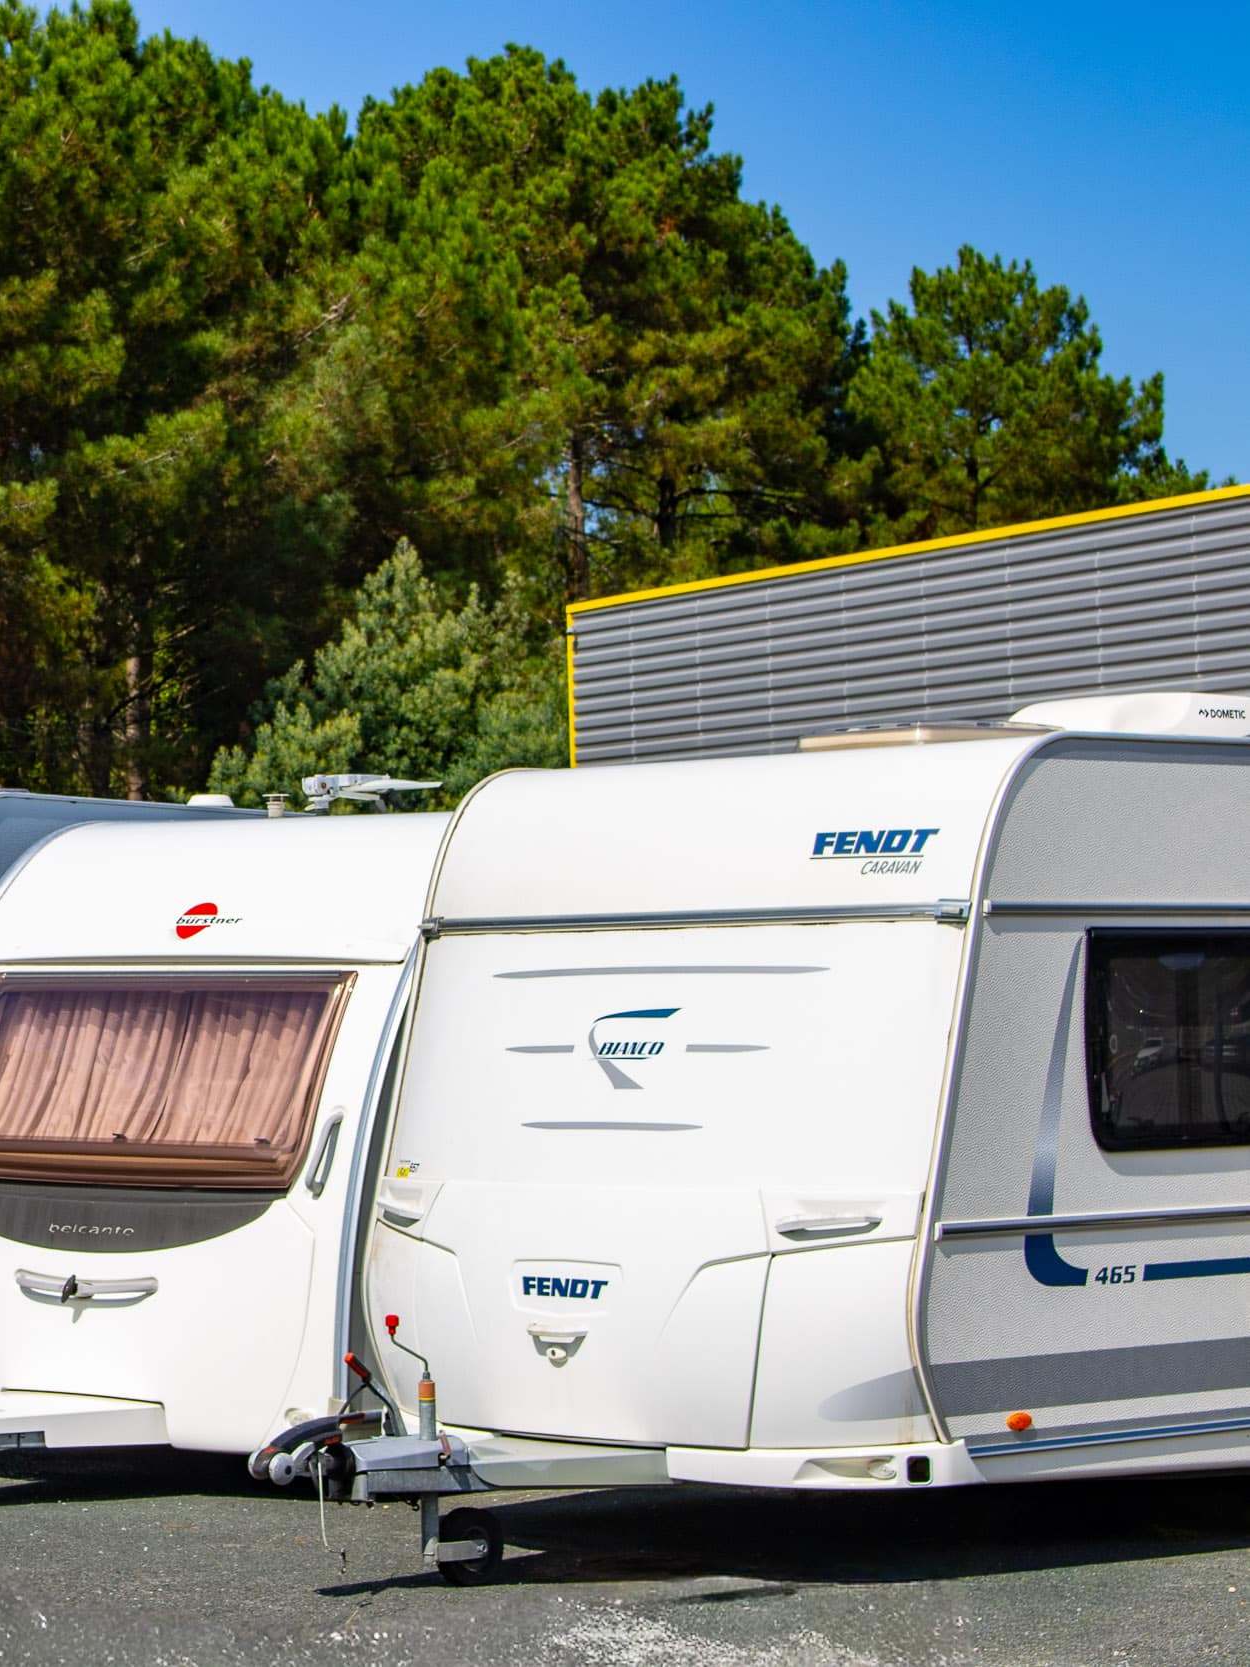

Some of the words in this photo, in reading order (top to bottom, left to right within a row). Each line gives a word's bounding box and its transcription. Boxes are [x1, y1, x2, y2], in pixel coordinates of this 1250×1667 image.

[1210, 708, 1246, 720] DOMETIC
[812, 828, 940, 855] FENDT
[860, 860, 923, 875] CARAVAN
[597, 1041, 665, 1055] BIANCO
[48, 1223, 135, 1236] belcanto
[1094, 1264, 1136, 1285] 465
[522, 1276, 608, 1300] FENDT
